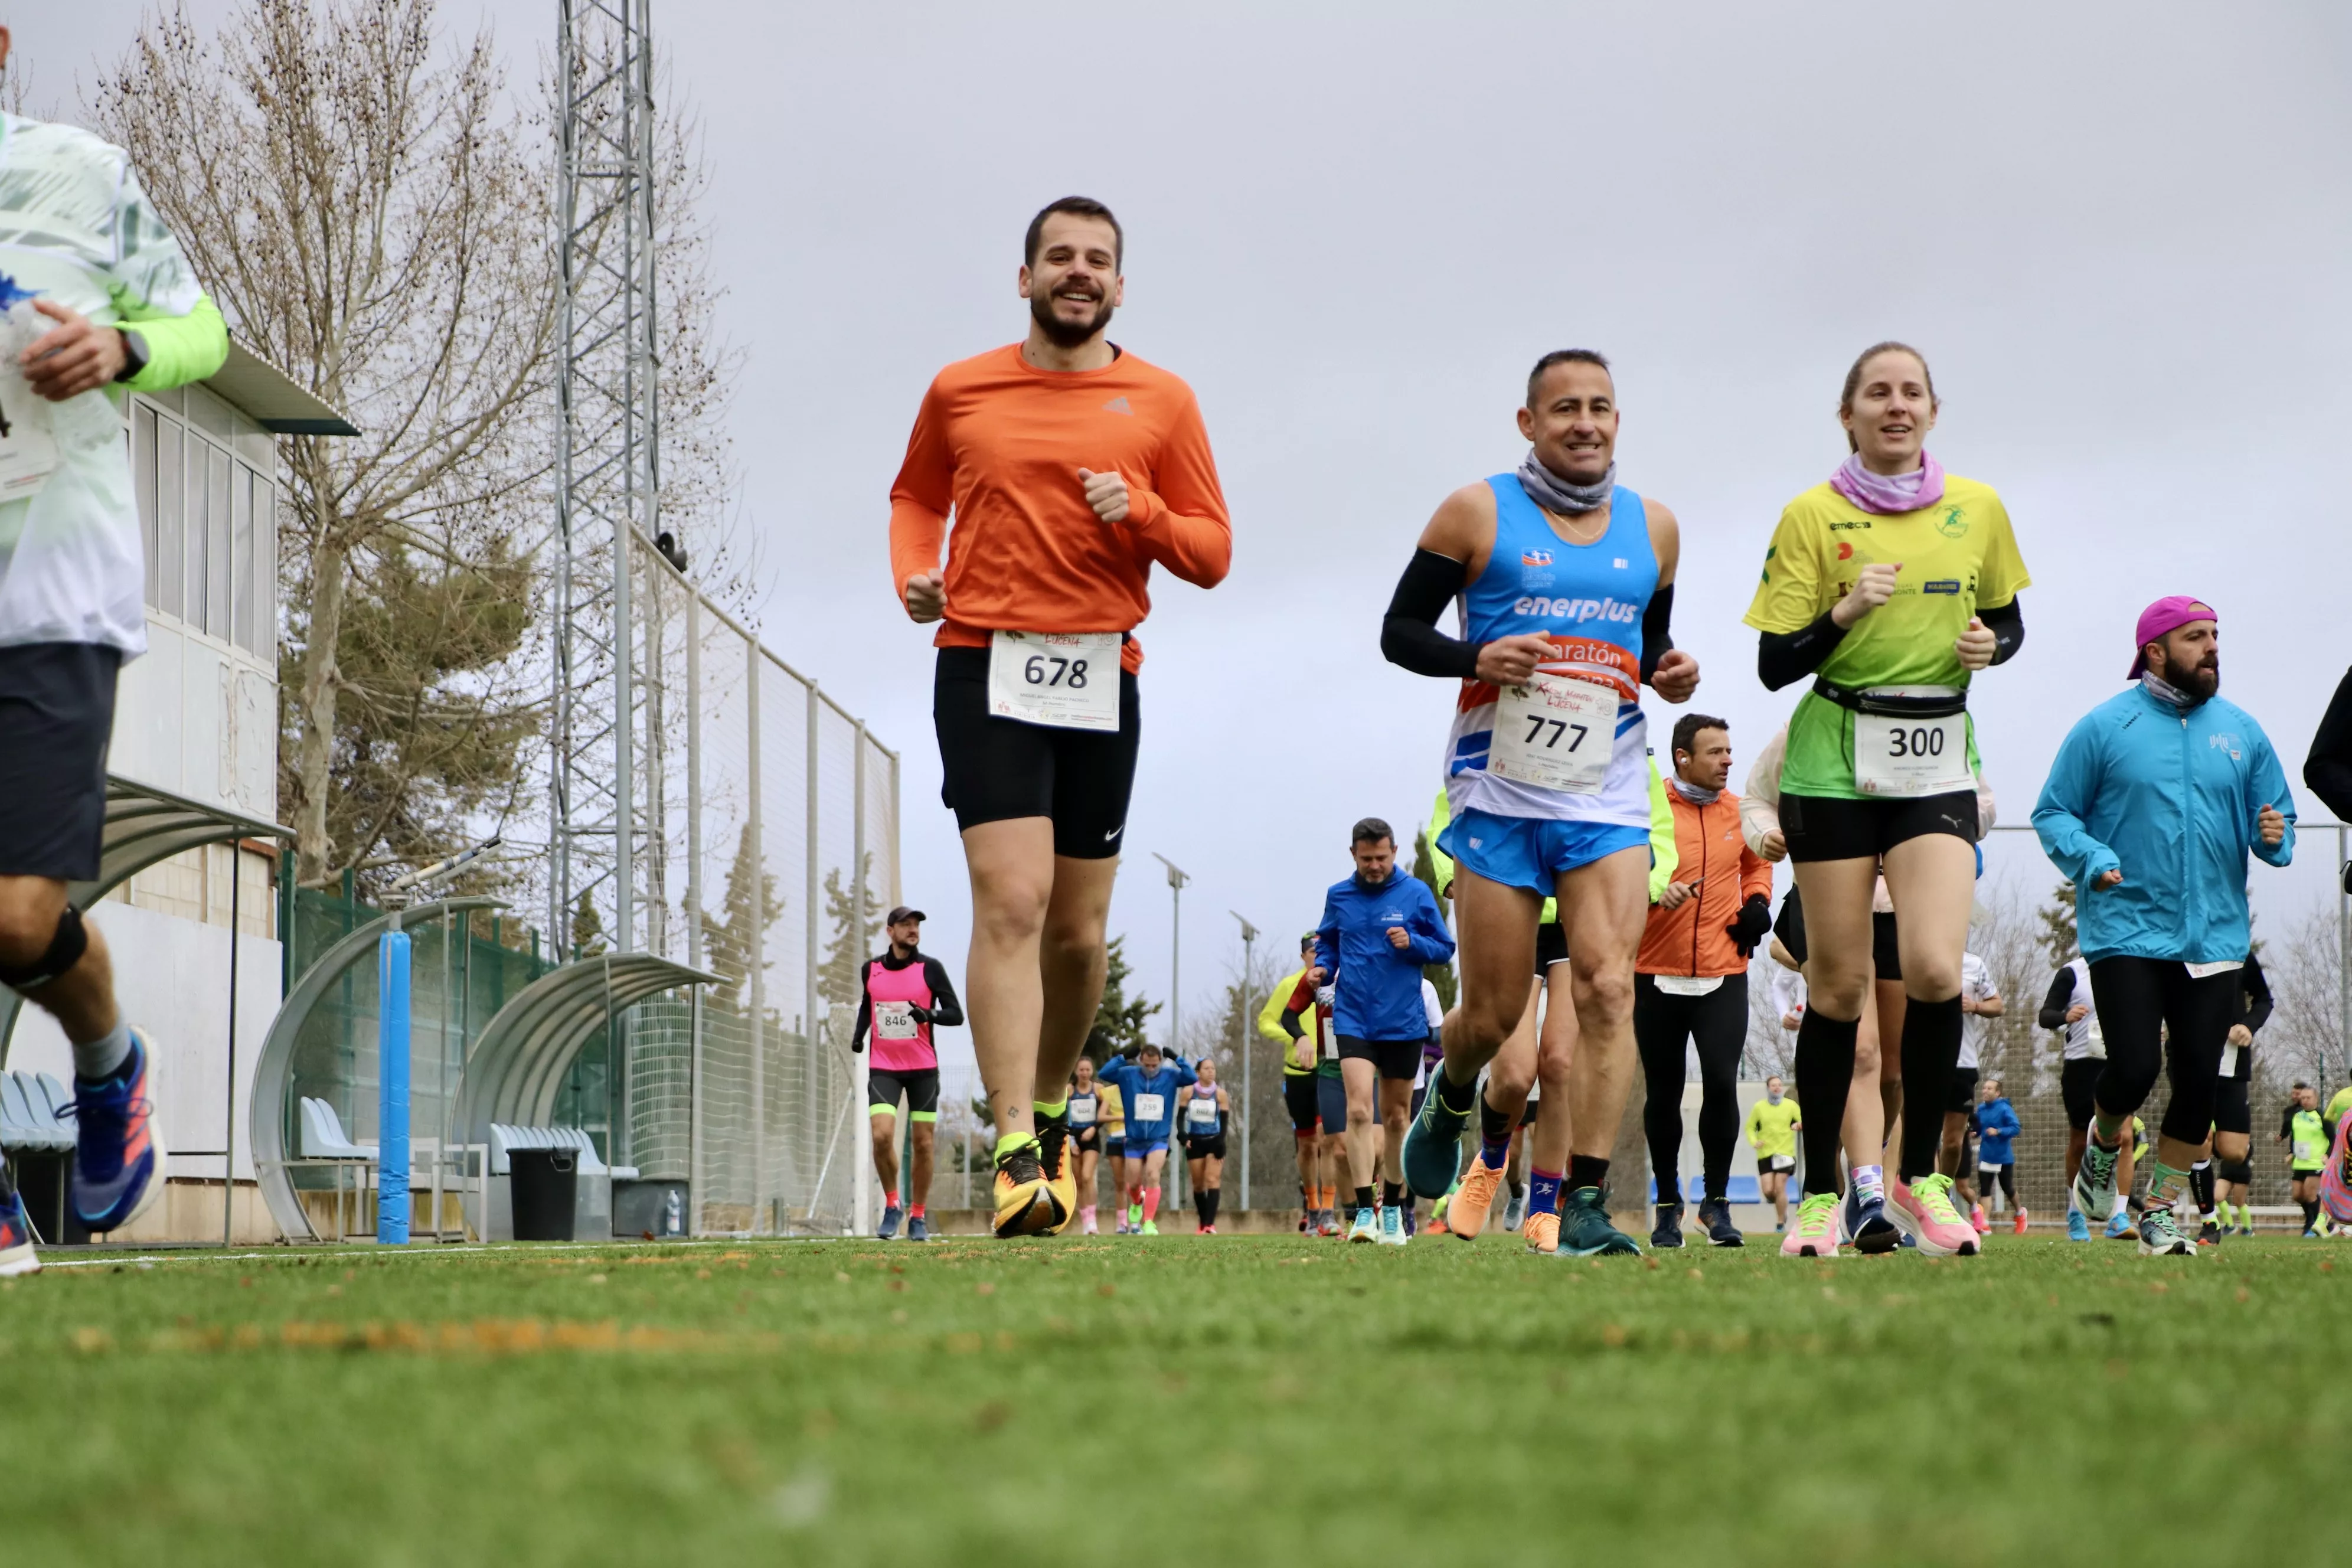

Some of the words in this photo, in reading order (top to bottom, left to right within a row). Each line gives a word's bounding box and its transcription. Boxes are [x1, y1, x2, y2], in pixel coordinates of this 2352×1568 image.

[1514, 596, 1639, 623] enerplus
[1045, 633, 1084, 647] LUCENA
[1535, 643, 1621, 667] aratón
[1025, 655, 1088, 689] 678
[1547, 695, 1583, 713] LUCENA
[1525, 714, 1589, 753] 777
[1889, 727, 1944, 757] 300
[885, 1015, 907, 1026] 846
[1142, 1103, 1158, 1112] 259
